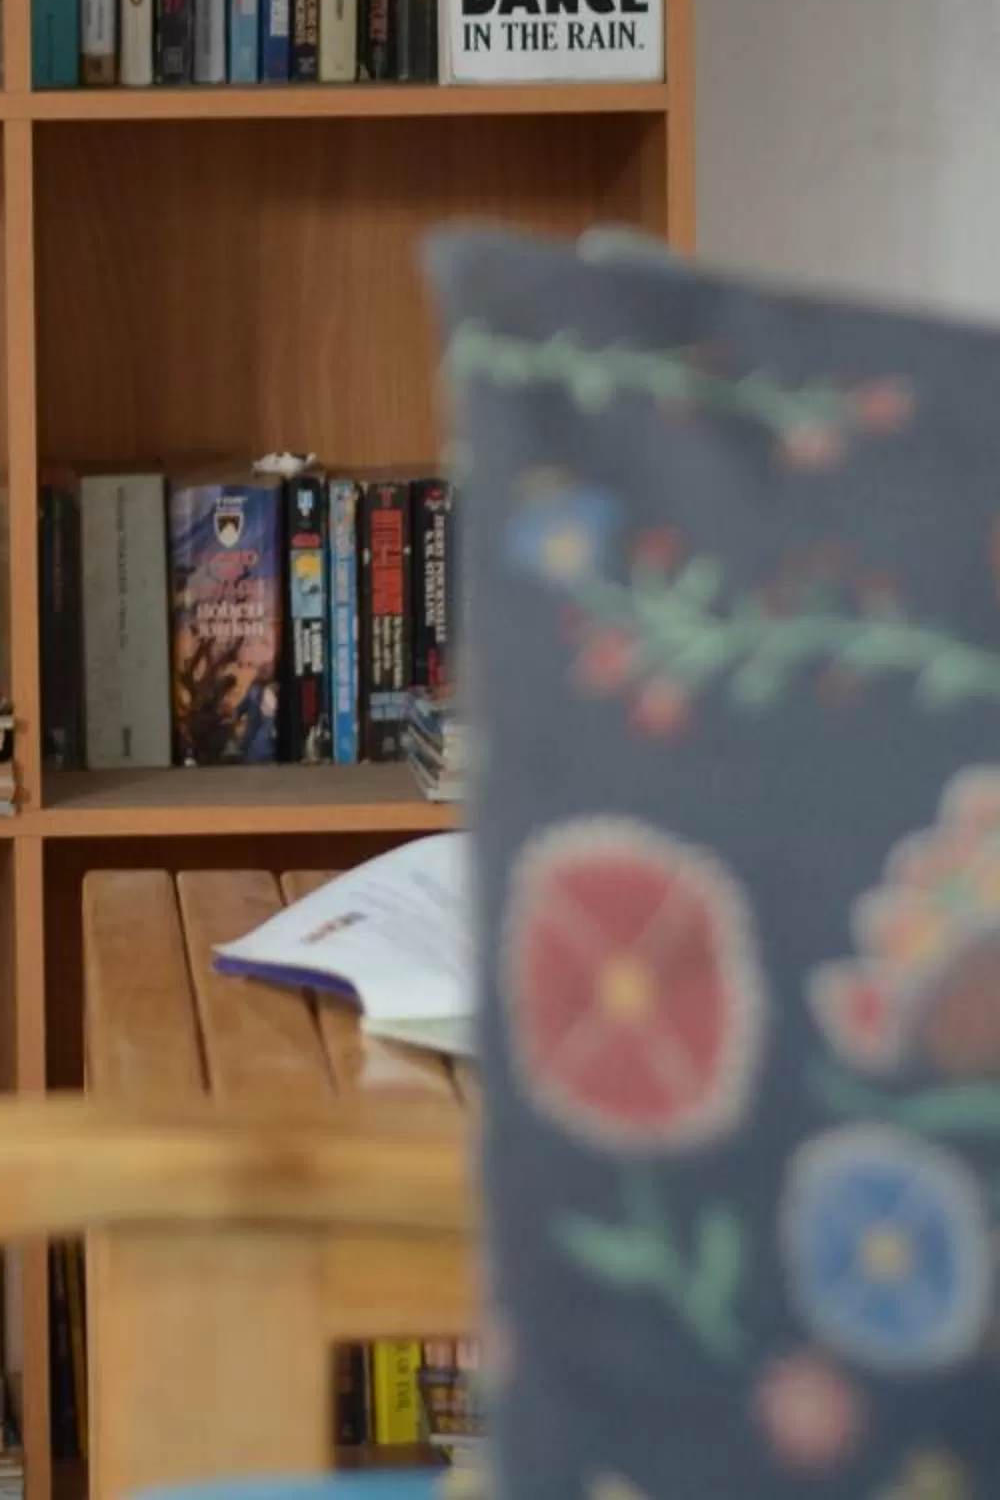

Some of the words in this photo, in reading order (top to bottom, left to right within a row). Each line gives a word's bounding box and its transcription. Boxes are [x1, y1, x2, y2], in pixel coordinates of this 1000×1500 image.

[463, 21, 491, 51] IN
[501, 21, 557, 51] THE
[566, 20, 646, 50] RAIN.
